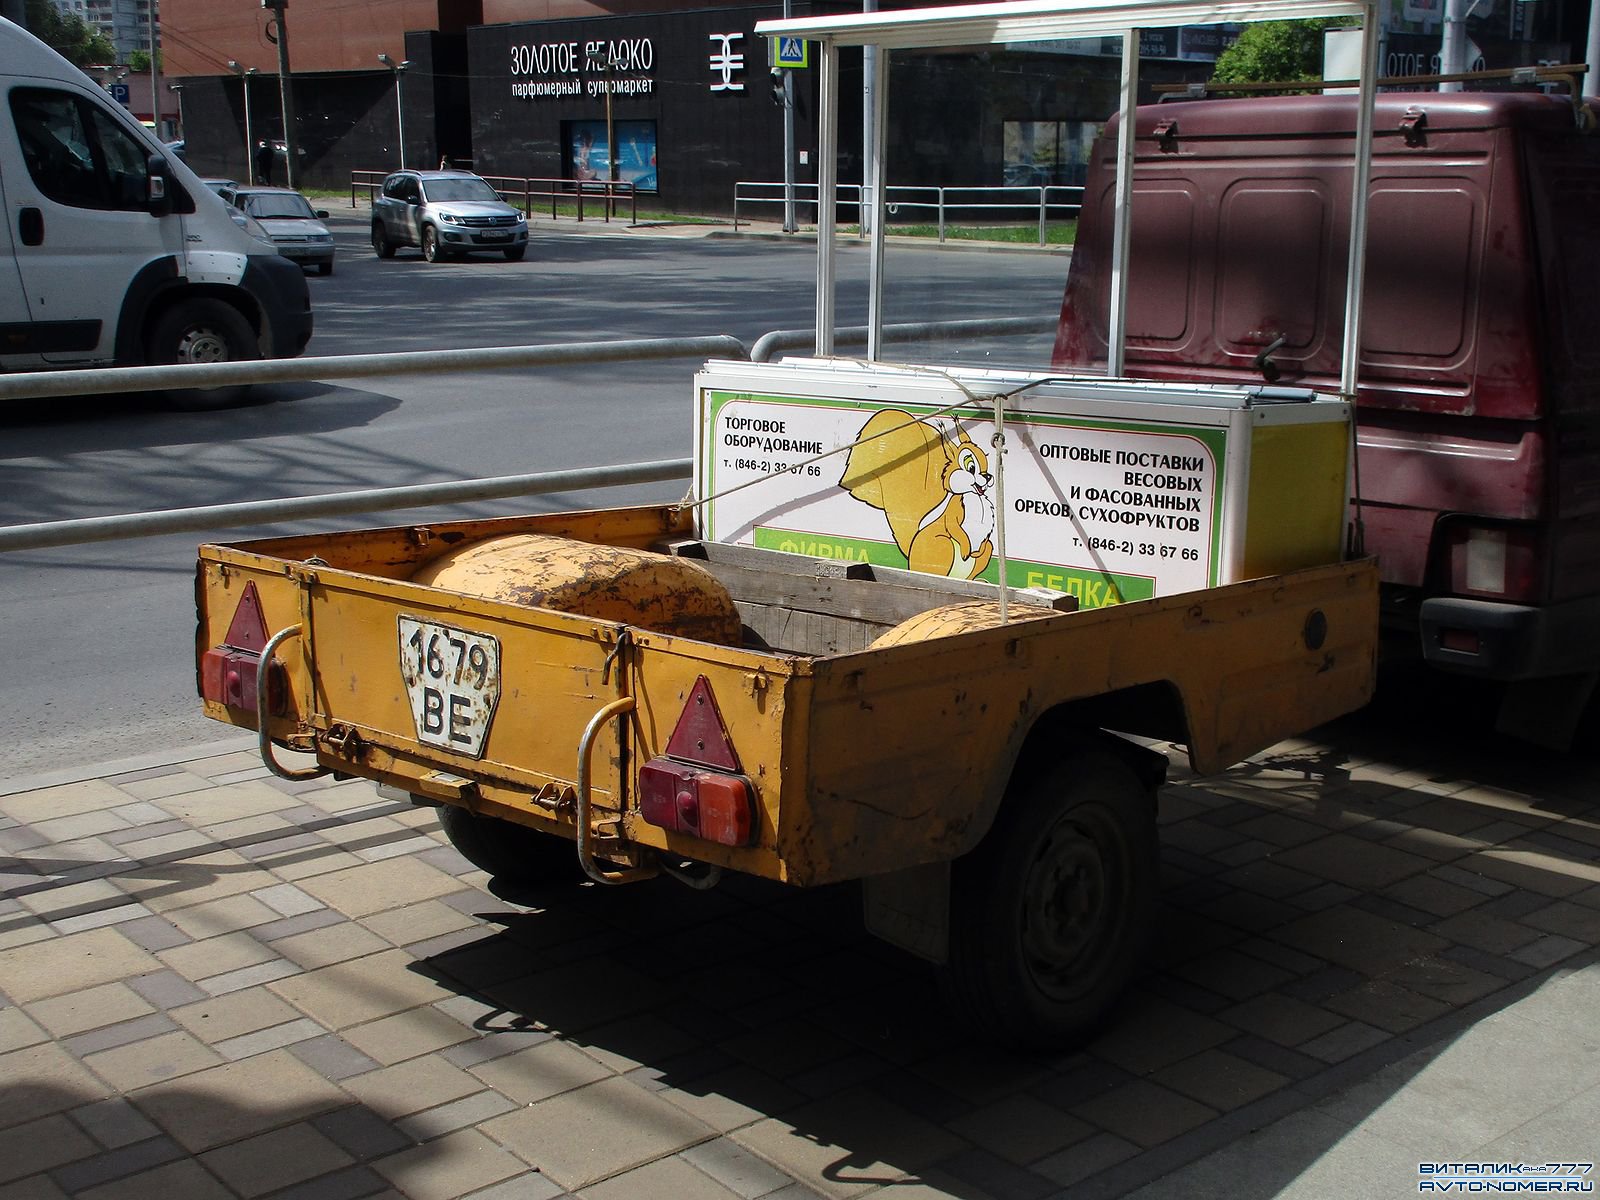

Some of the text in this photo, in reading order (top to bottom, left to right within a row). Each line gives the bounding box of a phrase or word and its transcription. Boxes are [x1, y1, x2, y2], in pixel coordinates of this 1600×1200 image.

[511, 42, 579, 75] ЗОЛОТОЕ
[115, 86, 126, 101] P
[512, 79, 581, 99] парфюмерный
[725, 416, 786, 434] ТОРГОВОЕ
[724, 434, 823, 455] ОБОРУДОВАНИЕ
[723, 459, 732, 468] т.
[735, 458, 771, 474] (846-2)
[807, 466, 821, 477] 66
[1039, 444, 1204, 472] ОПТОВЫЕ ПОСТАВКИ
[1124, 471, 1202, 492] ВЕСОВЫХ
[1070, 485, 1201, 512] И ФАСОВАННЫХ
[1014, 498, 1200, 532] ОРЕХОВ, СУХОФРУКТОВ
[780, 539, 870, 564] ФИРМА
[1072, 536, 1199, 561] т. (846-2) 33 67 66
[409, 629, 489, 690] 1679
[423, 686, 472, 744] ВЕ
